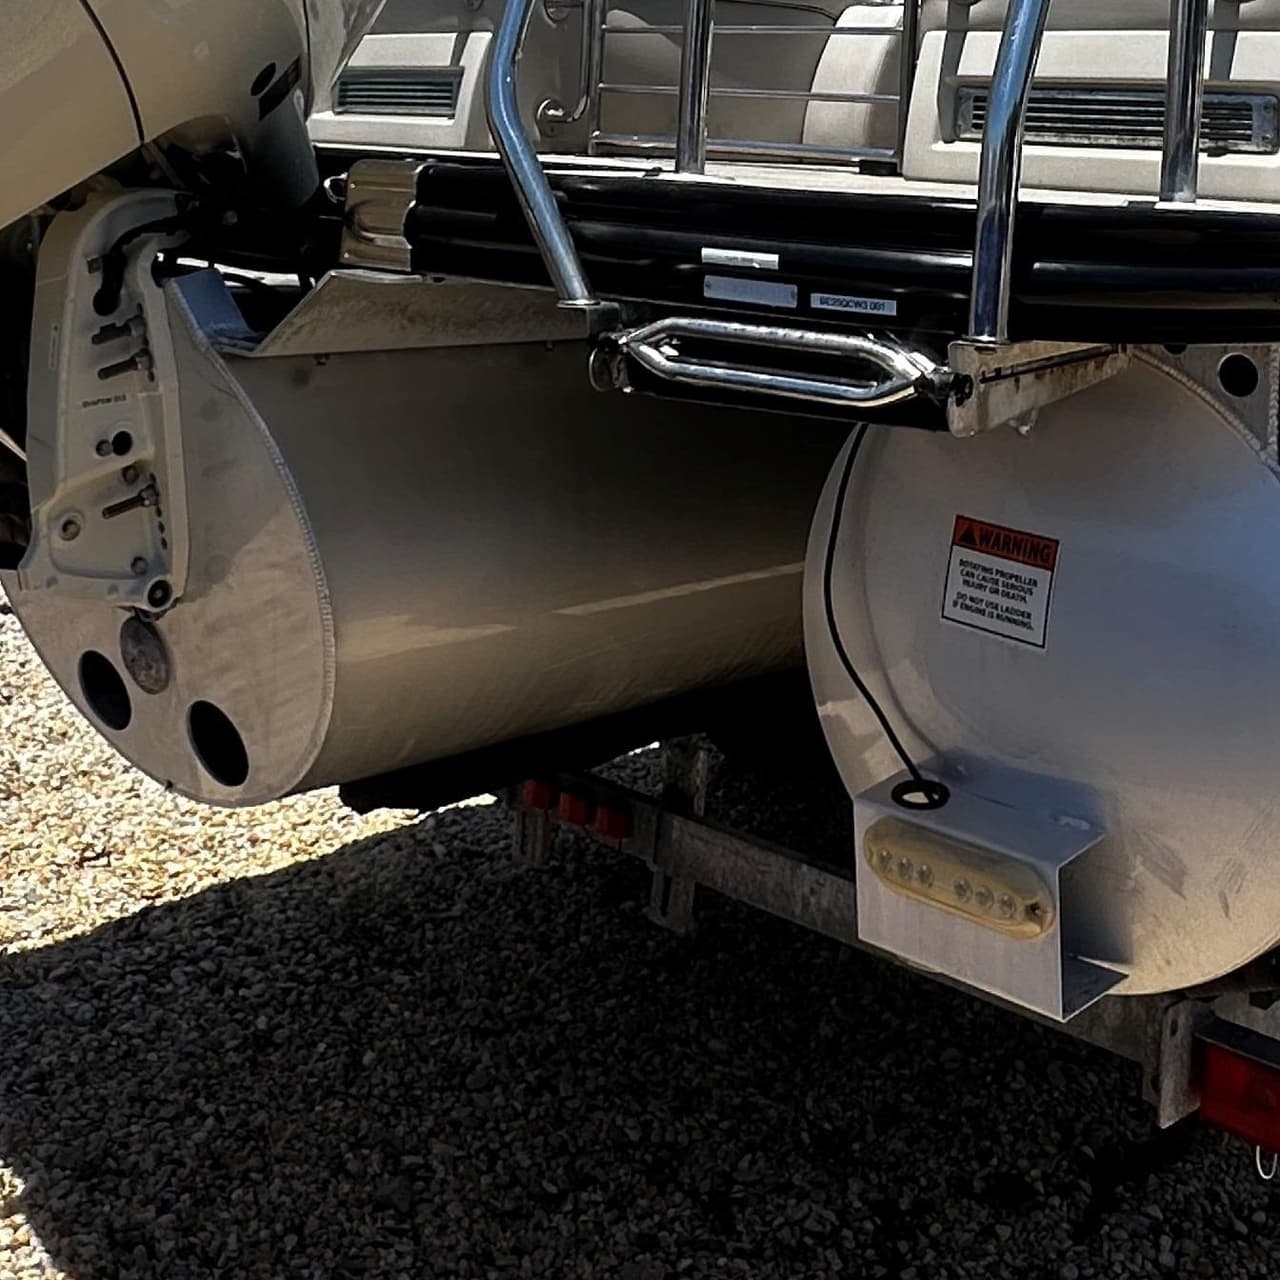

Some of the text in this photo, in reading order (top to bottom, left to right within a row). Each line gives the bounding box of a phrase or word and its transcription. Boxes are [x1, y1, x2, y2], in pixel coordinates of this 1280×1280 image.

[980, 529, 1051, 561] WARNING
[960, 568, 1033, 596] CAN CAUSE SERIOUS
[988, 585, 1000, 595] OR
[994, 568, 1038, 588] PROPELLER
[956, 592, 1032, 620] DO NOT USE LADDER
[960, 602, 986, 616] ENGINE
